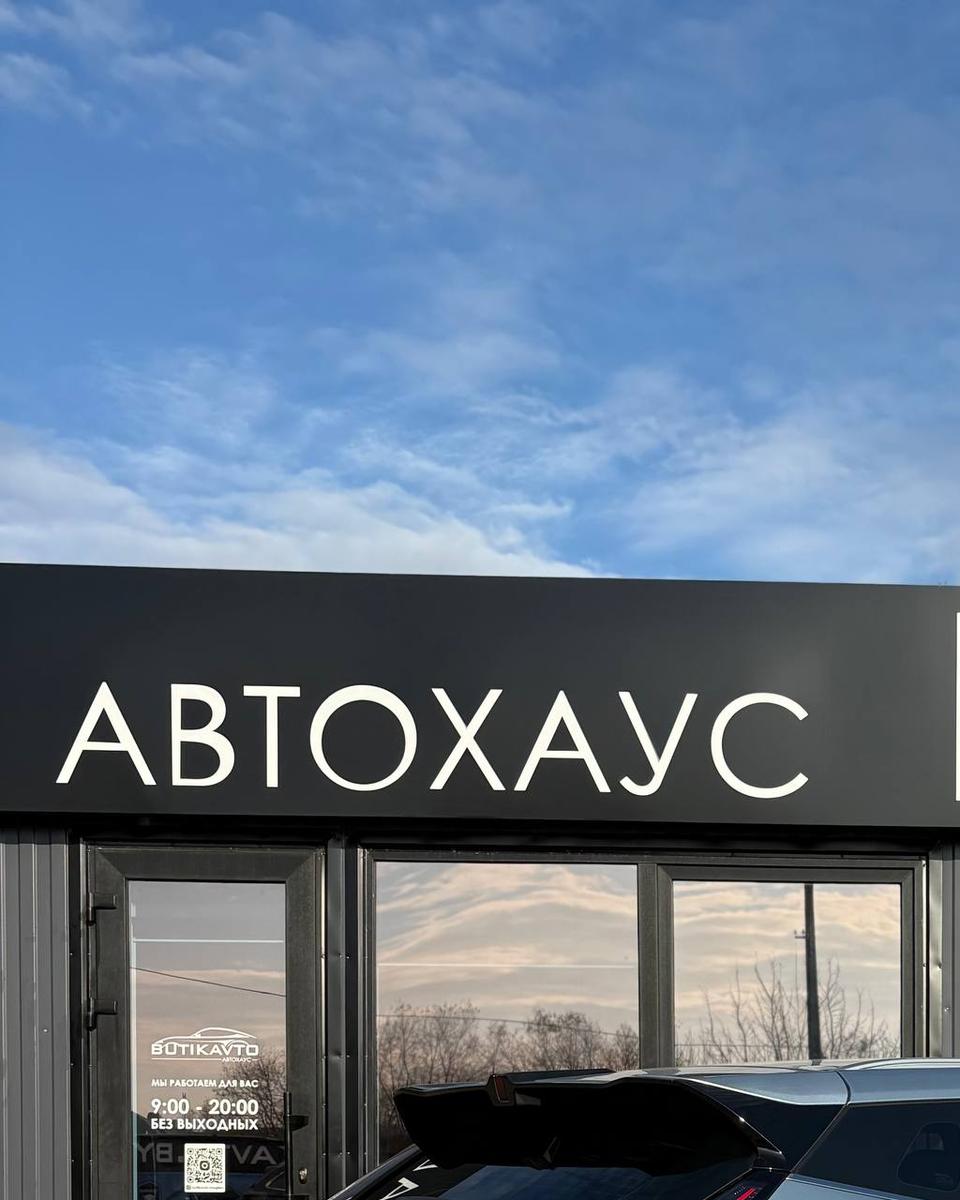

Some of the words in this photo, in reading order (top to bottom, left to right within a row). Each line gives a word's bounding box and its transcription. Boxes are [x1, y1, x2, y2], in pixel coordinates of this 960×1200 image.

[56, 681, 809, 799] АВТОХАУС
[151, 1043, 259, 1056] BUTIKAVTO
[151, 1079, 167, 1087] МЫ
[169, 1079, 217, 1088] РАБОТАЕМ
[218, 1079, 238, 1088] ДЛЯ
[239, 1079, 259, 1088] ВАС
[151, 1099, 189, 1114] 9:00
[208, 1099, 259, 1115] 20:00
[151, 1119, 173, 1130] БЕЗ
[177, 1119, 259, 1131] ВЫХОДНЫХ
